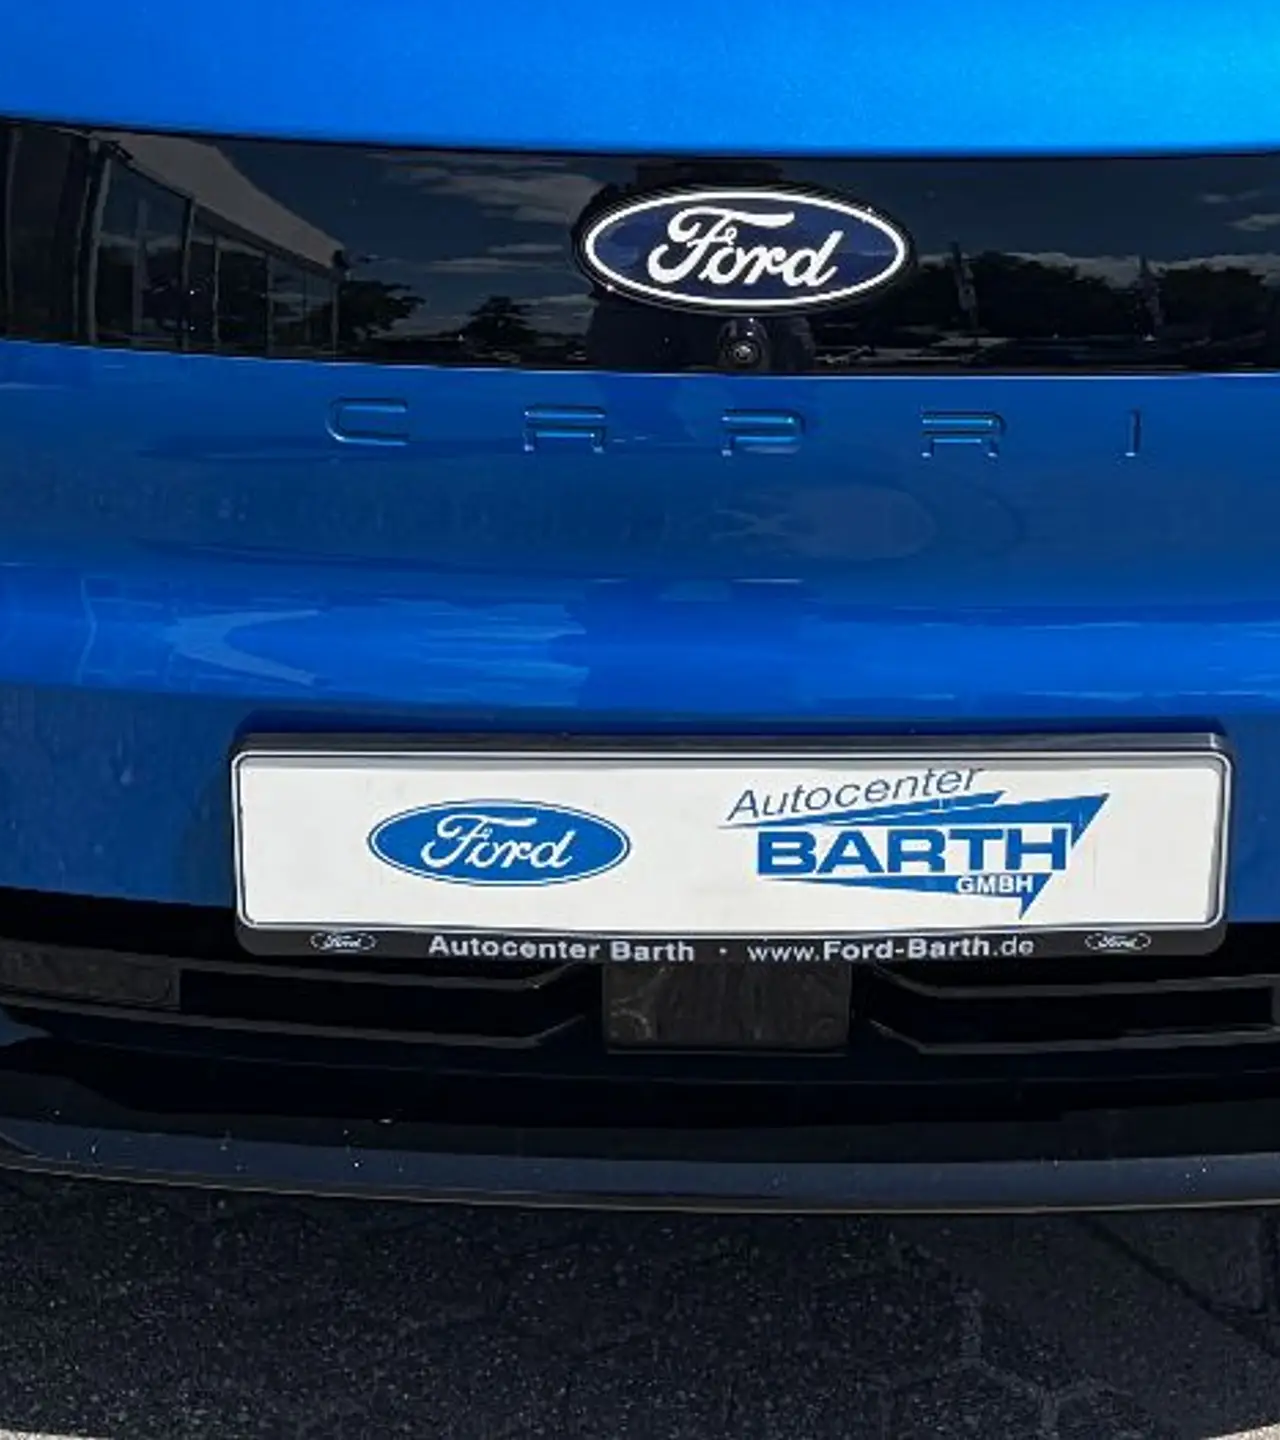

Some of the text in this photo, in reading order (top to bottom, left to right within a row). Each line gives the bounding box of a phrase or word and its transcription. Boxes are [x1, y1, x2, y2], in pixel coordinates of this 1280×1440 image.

[646, 206, 845, 288] Ford
[324, 397, 1143, 458] CAPRI
[725, 767, 985, 822] Autocenter
[420, 813, 579, 870] Ford
[757, 827, 1068, 875] BARTH
[955, 875, 1035, 895] GMBH
[428, 935, 1035, 962] Autocenter Barth www.Ford-Barth.de
